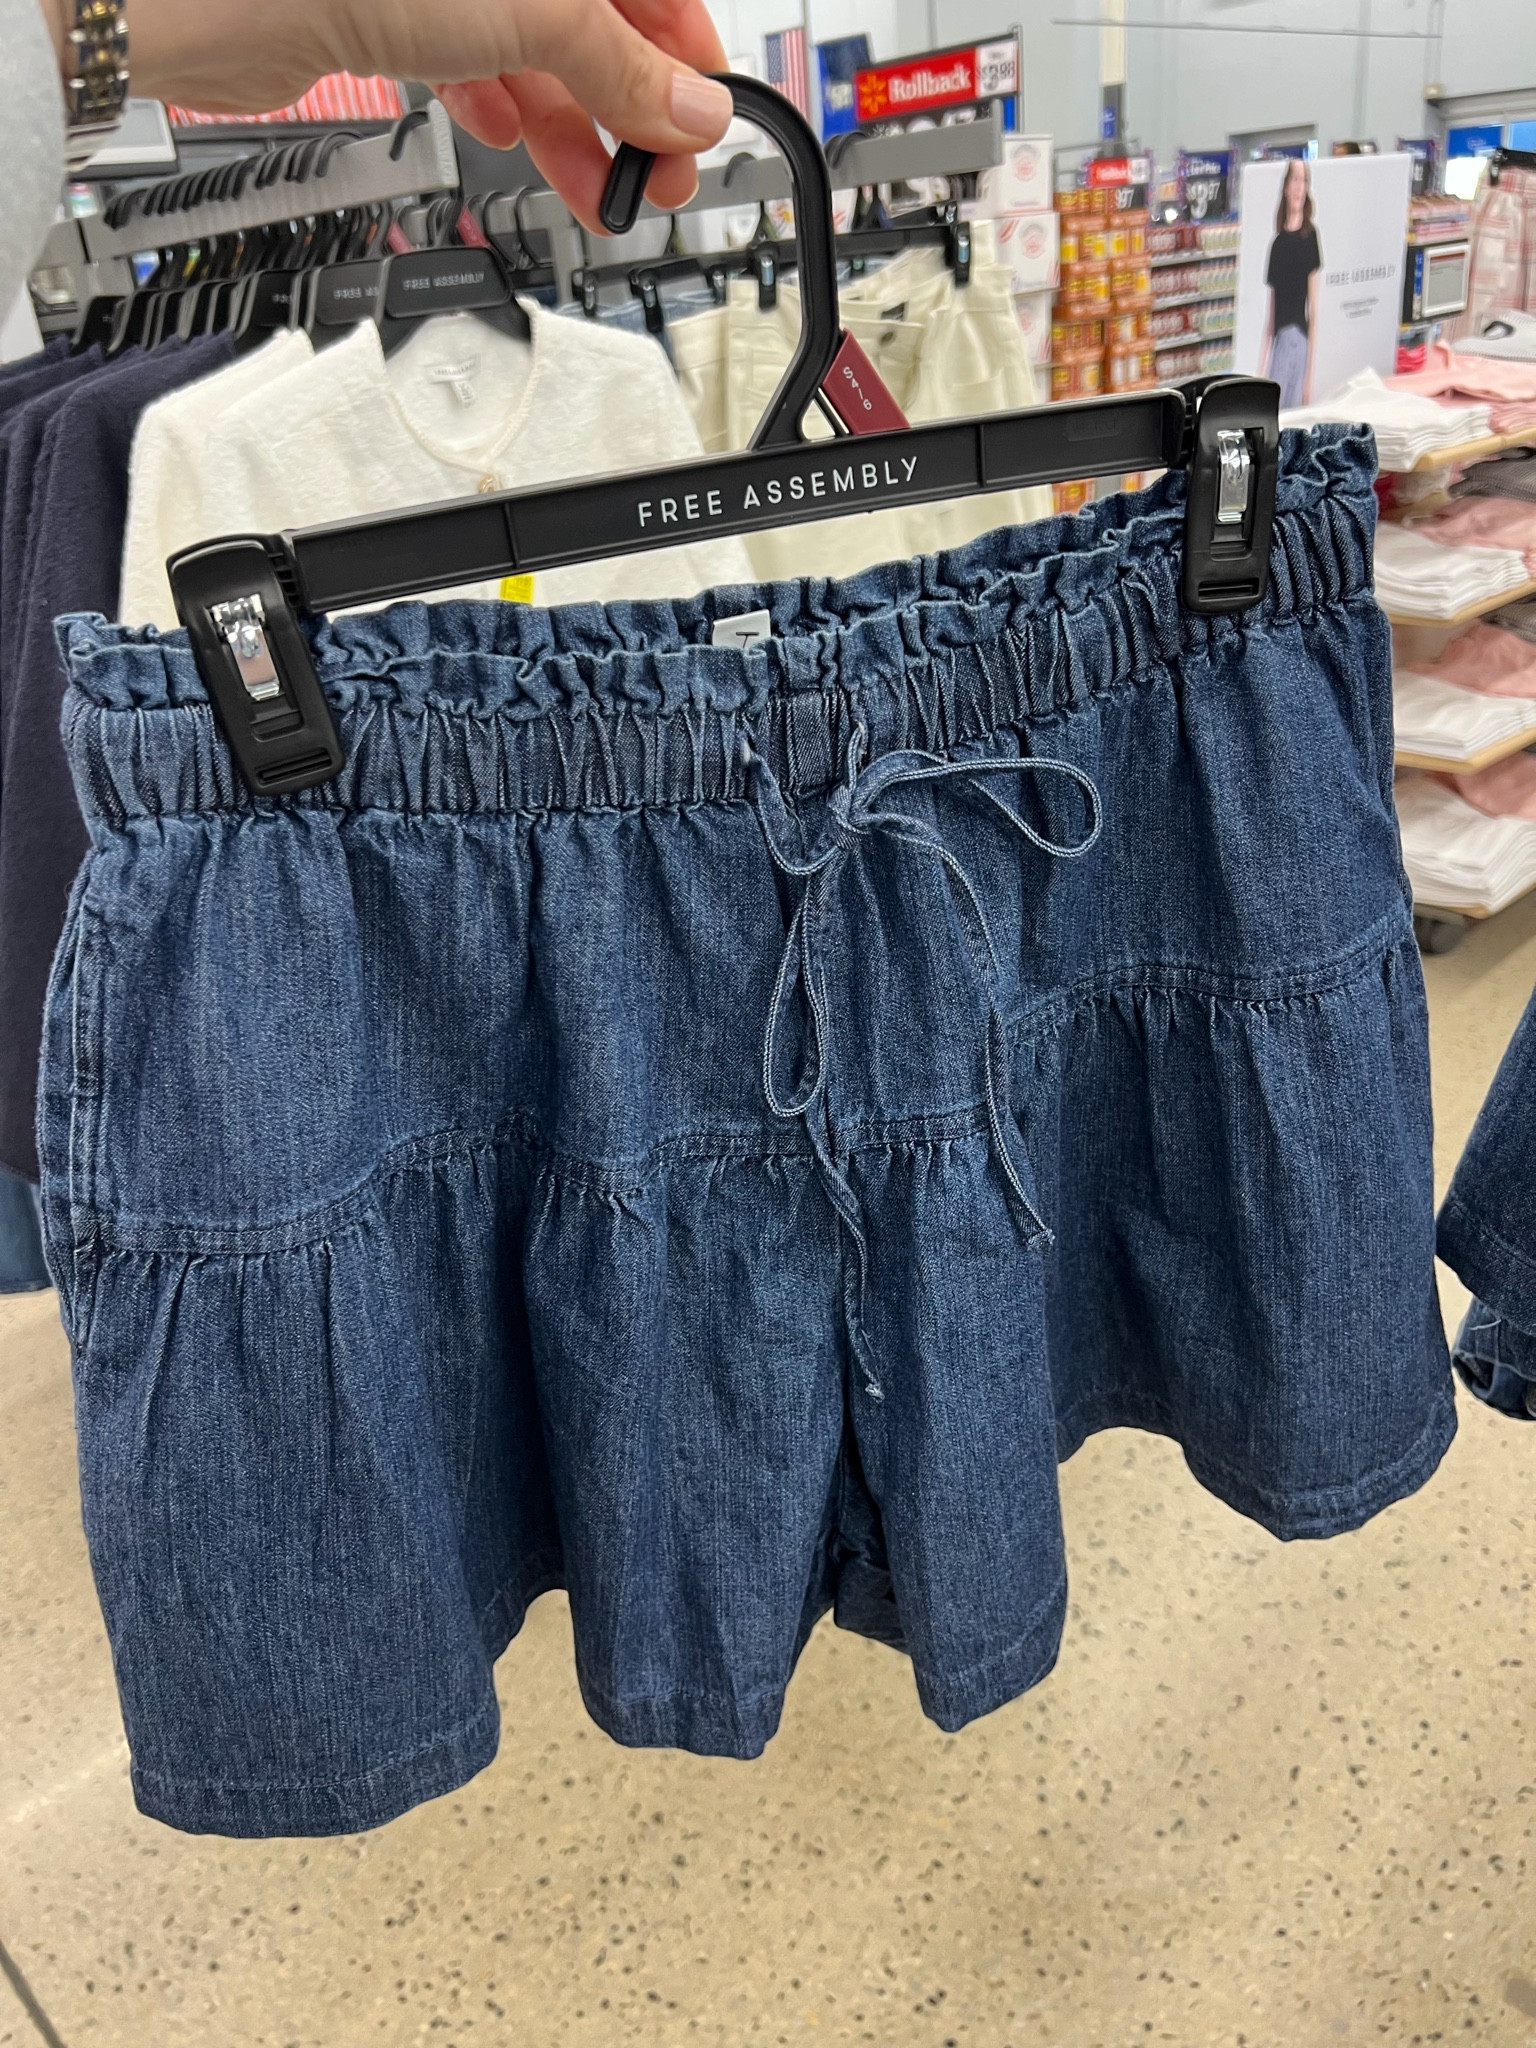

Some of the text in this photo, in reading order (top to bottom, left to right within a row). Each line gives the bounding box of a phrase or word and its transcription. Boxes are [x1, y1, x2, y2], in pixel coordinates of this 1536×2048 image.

[888, 63, 972, 103] Rollback
[333, 287, 362, 300] FREE
[403, 271, 485, 291] FREE ASSEMBLY
[638, 456, 917, 527] FREE ASSEMBLY
